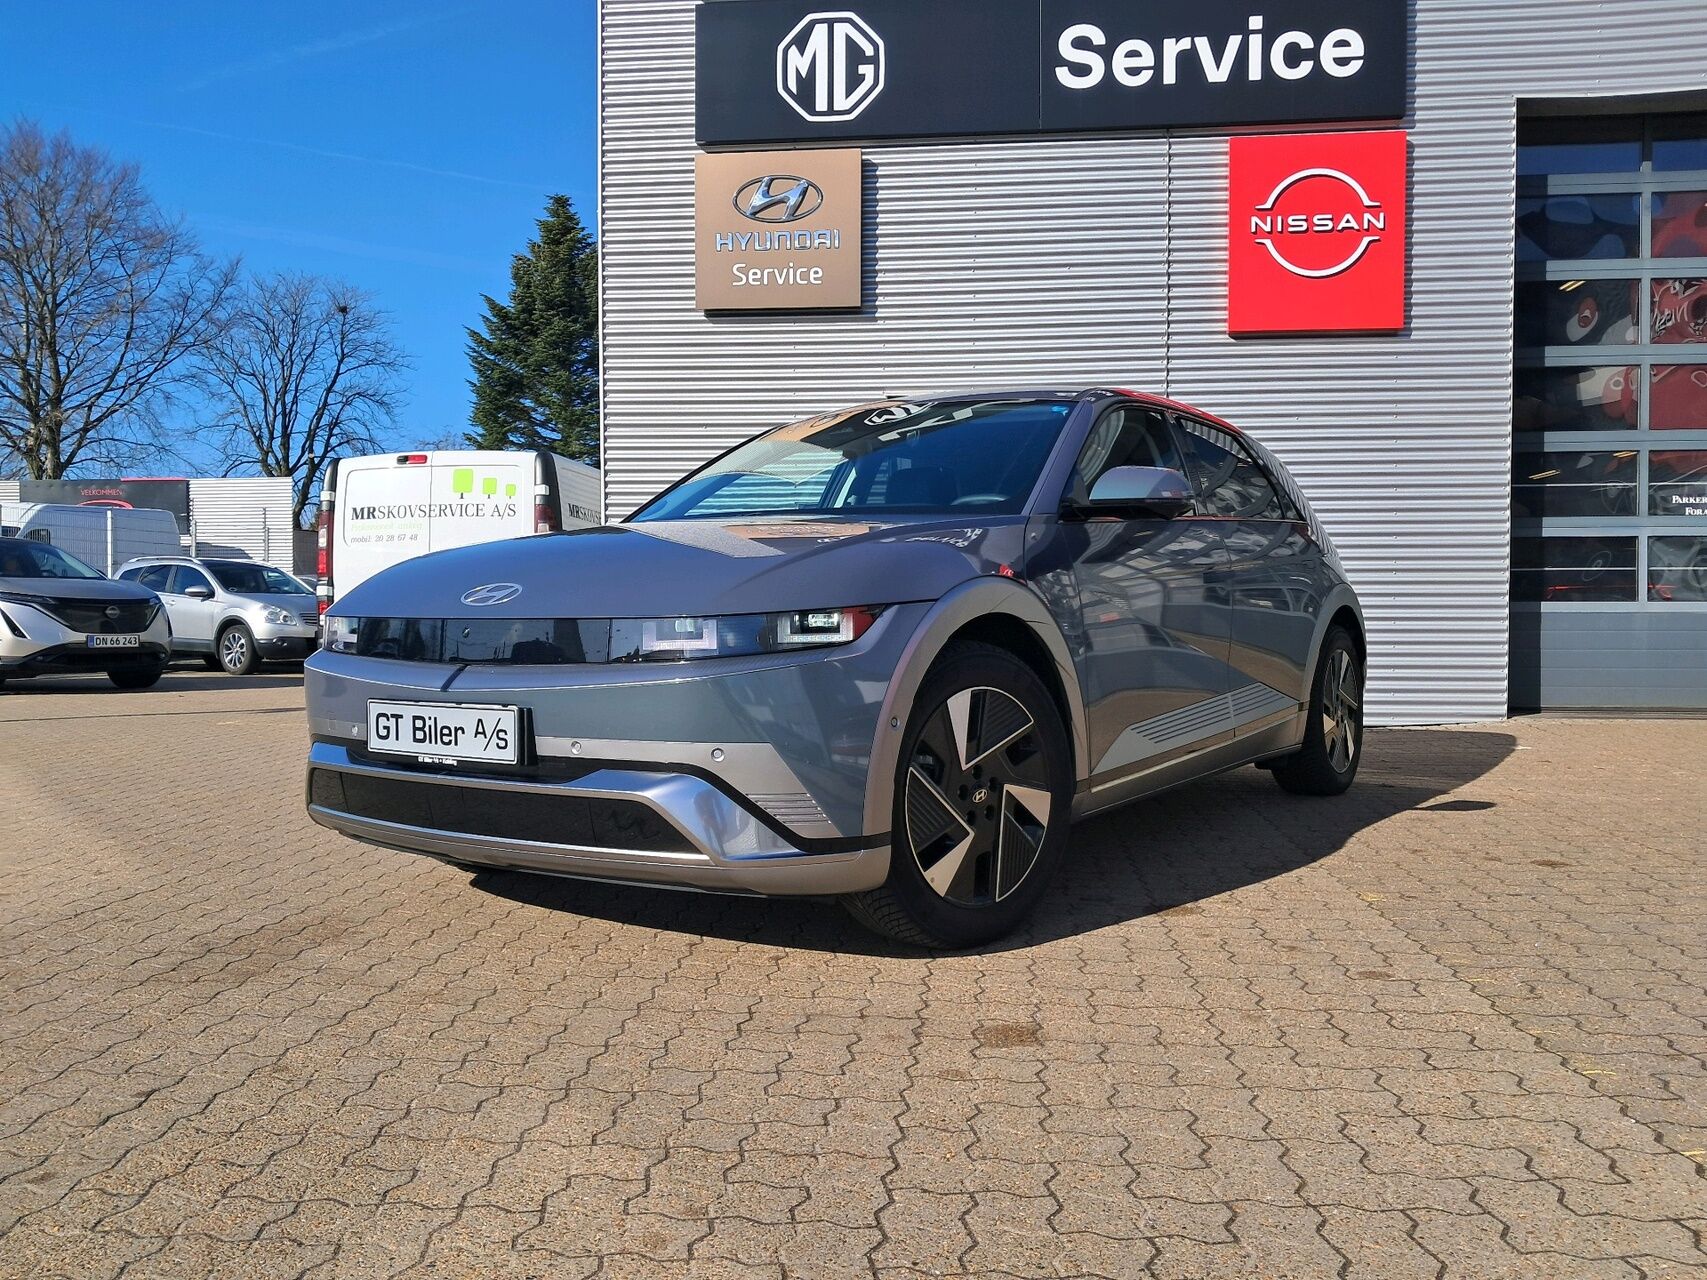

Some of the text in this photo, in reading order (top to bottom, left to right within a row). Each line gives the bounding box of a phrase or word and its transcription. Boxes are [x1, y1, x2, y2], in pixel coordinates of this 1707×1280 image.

[785, 14, 1366, 113] MG Service
[1250, 211, 1385, 235] NISSAN
[715, 229, 841, 252] HYUNDAI
[732, 261, 823, 286] Service
[80, 488, 123, 496] VELKOMMEN
[351, 502, 517, 521] MRSKOVSERVICE A/S
[386, 534, 395, 542] 28
[95, 636, 138, 646] DN 66 243
[375, 712, 508, 752] GT Biler A/S
